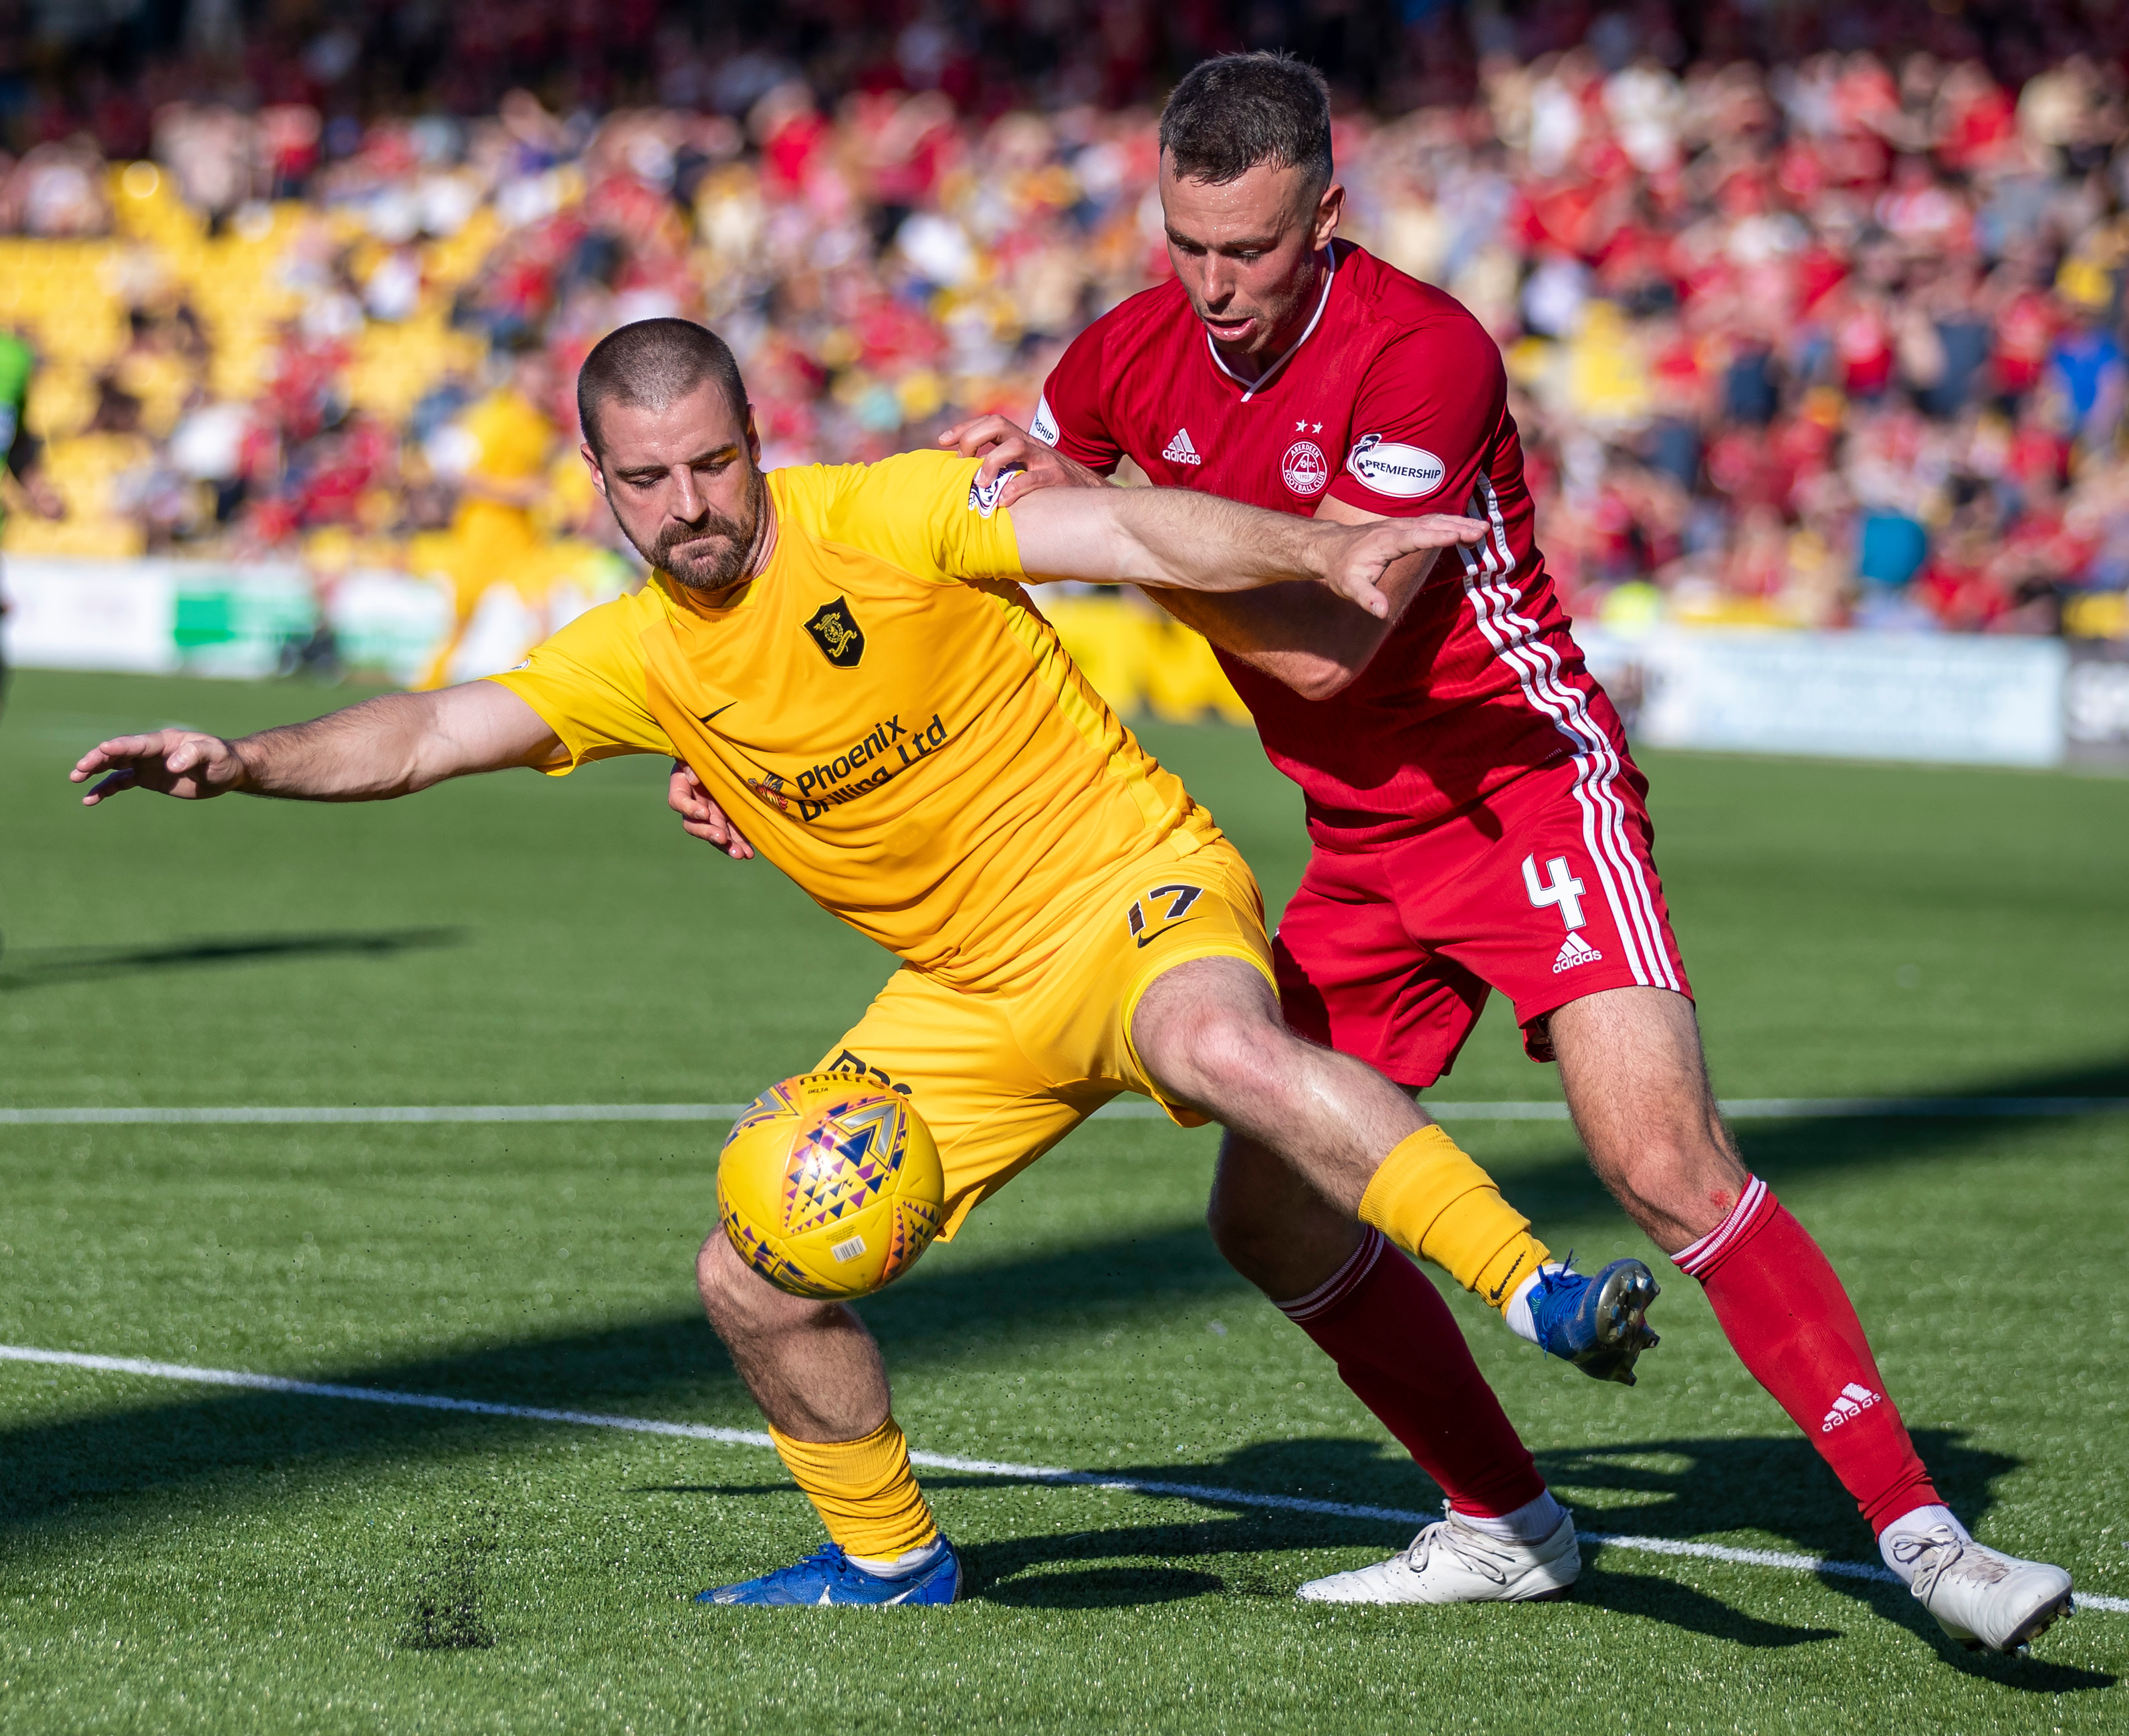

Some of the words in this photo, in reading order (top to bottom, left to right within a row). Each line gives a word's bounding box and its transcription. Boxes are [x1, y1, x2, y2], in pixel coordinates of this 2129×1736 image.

[1162, 449, 1201, 465] adidas
[1290, 443, 1320, 459] ABERDEEN
[1284, 469, 1315, 492] FOOTBALL
[1313, 471, 1325, 487] CLUB
[1365, 459, 1441, 479] PREMIERSHIP
[897, 714, 948, 764] Ltd
[796, 714, 908, 798] Phoenix
[1521, 853, 1587, 931] 4
[1127, 883, 1204, 938] 17
[1552, 950, 1602, 974] adidas
[800, 1073, 885, 1090] mitre
[1822, 1393, 1882, 1432] adidas
